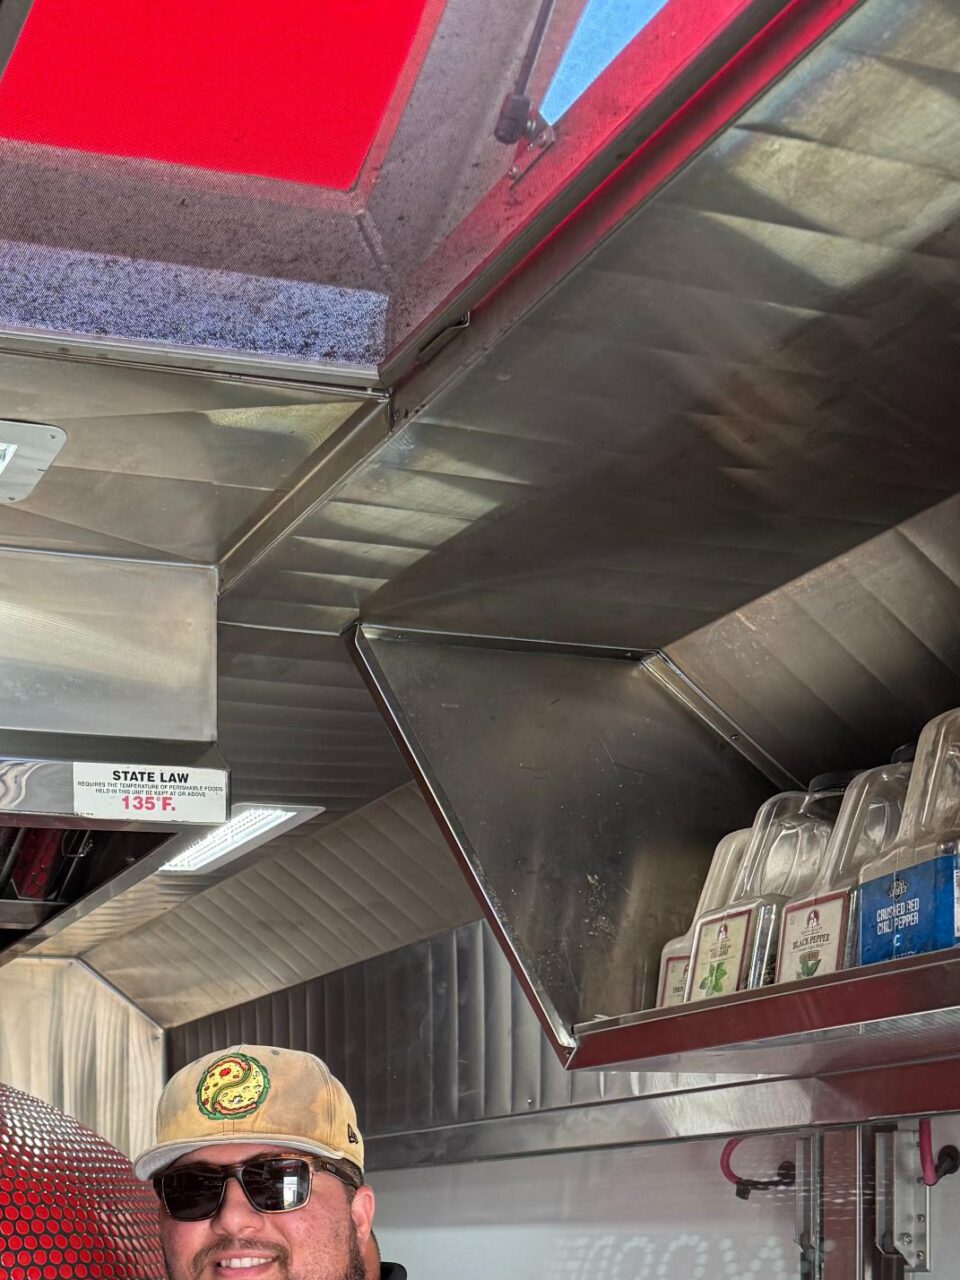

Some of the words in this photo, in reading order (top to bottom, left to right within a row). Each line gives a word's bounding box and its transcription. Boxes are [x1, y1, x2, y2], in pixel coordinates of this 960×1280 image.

[112, 770, 155, 783] STATE
[160, 772, 189, 784] LAW
[906, 898, 920, 913] RED
[894, 911, 919, 929] PEPPER
[793, 936, 810, 950] BLACK
[809, 933, 830, 944] PEPPER
